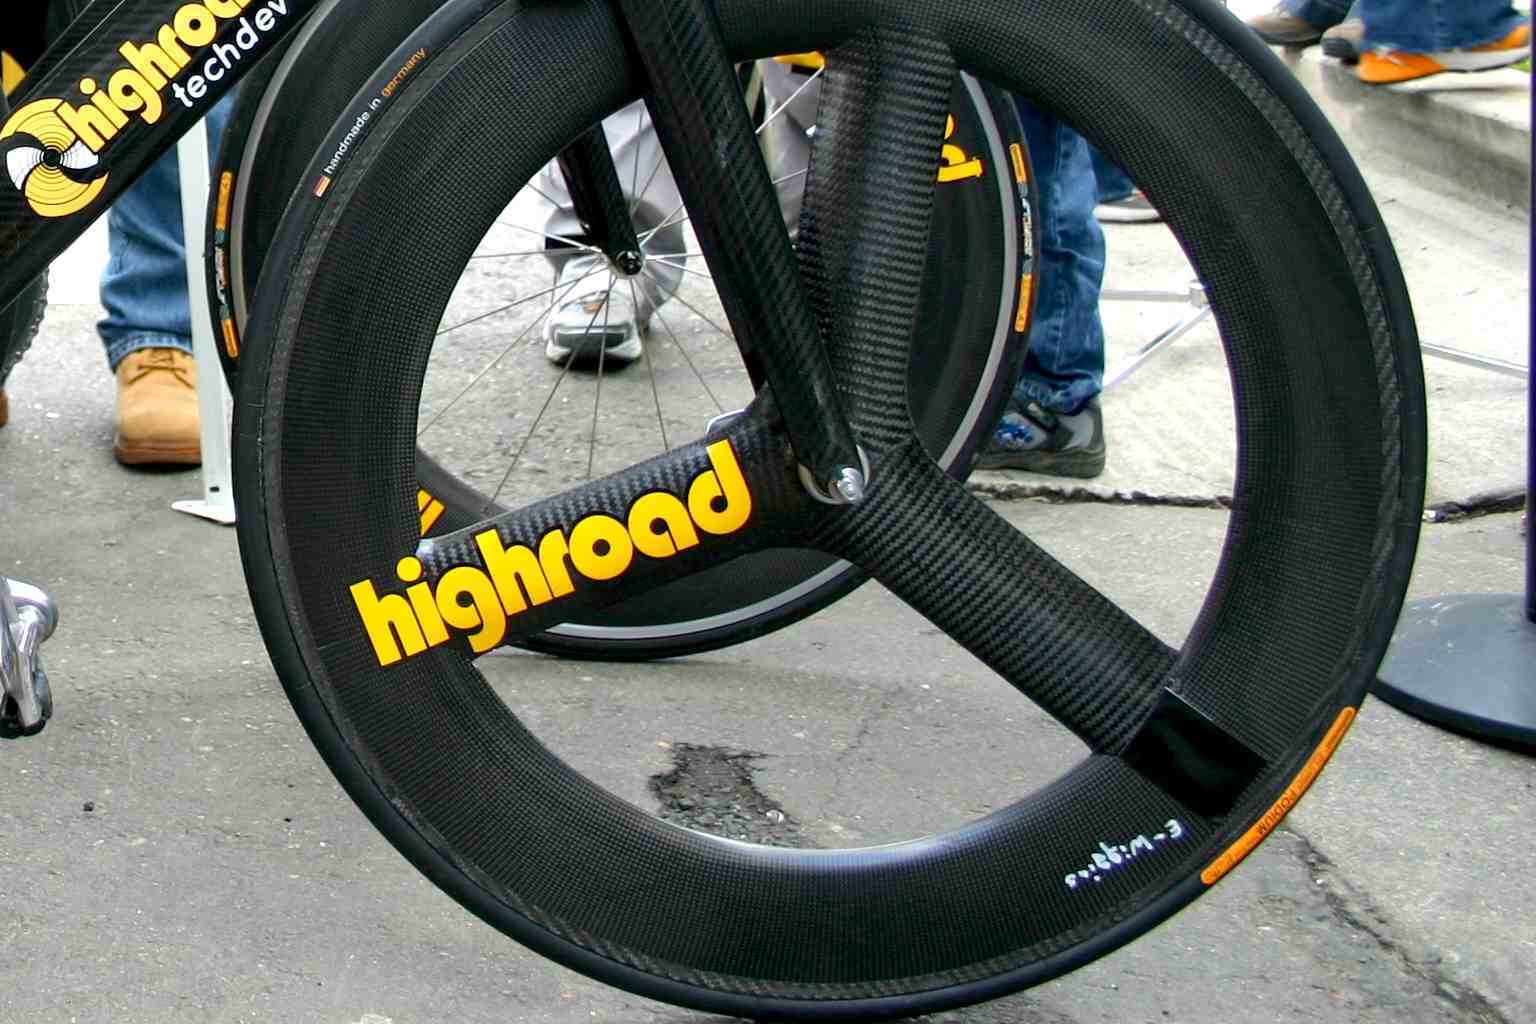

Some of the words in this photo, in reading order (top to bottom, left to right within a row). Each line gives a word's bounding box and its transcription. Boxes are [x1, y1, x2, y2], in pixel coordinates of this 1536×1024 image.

[323, 111, 371, 175] handmade
[367, 97, 383, 112] in
[381, 47, 427, 97] germany
[349, 438, 753, 668] highroad
